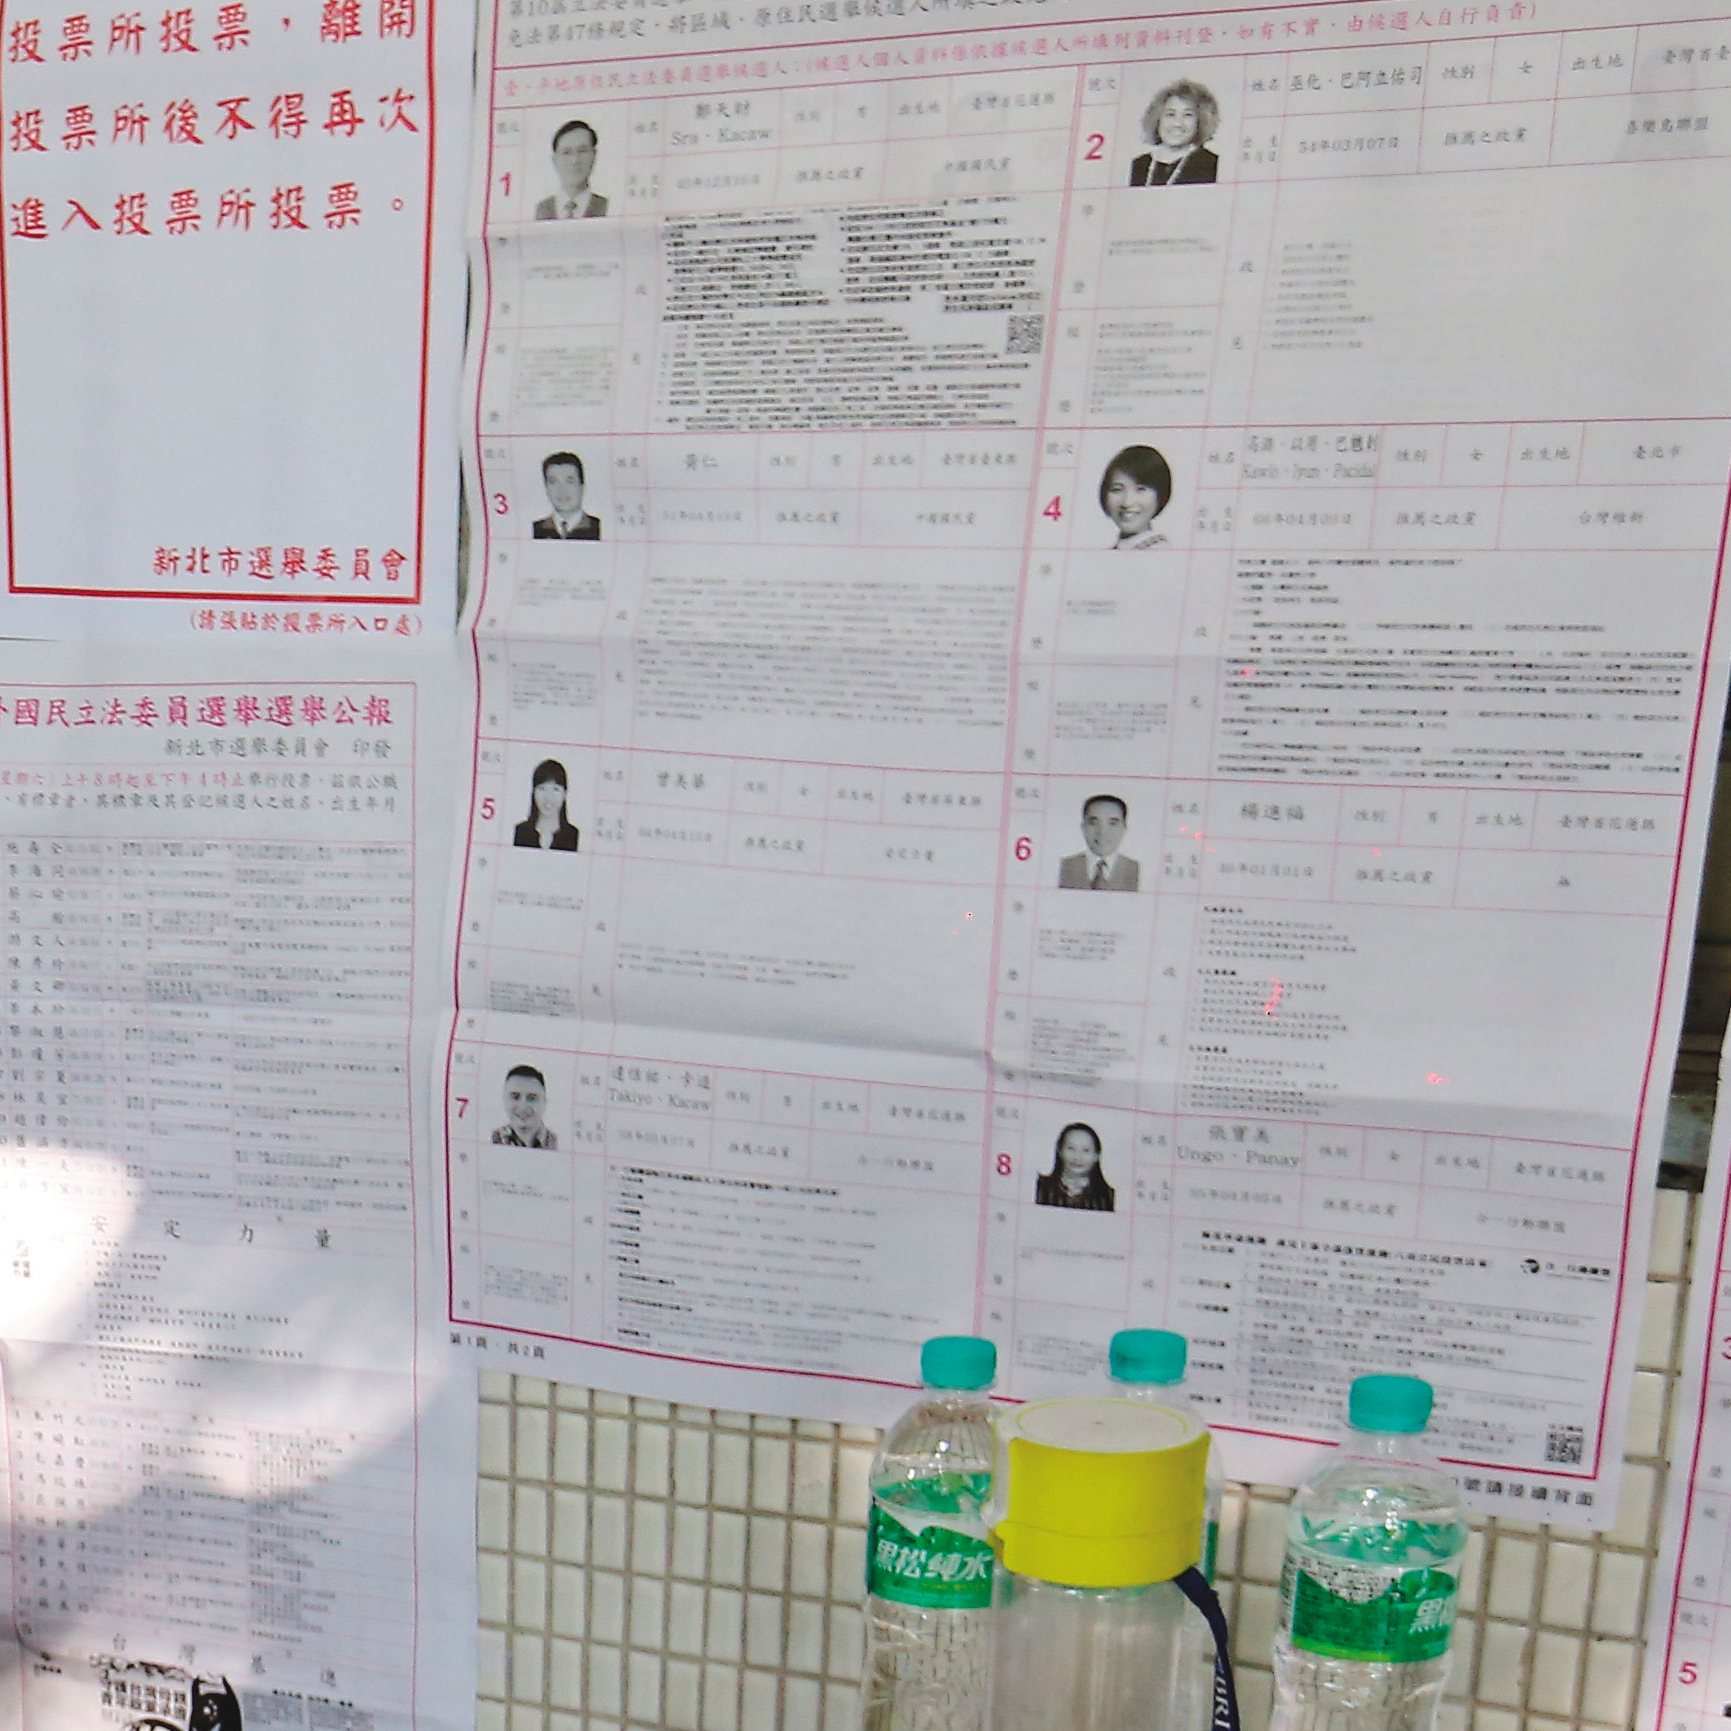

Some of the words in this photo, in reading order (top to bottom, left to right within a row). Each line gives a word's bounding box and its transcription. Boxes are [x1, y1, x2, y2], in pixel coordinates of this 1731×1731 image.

[8, 87, 420, 152] 投票所後不得再次
[1083, 134, 1106, 161] 2
[500, 172, 511, 197] 1
[11, 182, 404, 239] 進入投票所投票。
[494, 493, 510, 515] 3
[1043, 496, 1062, 521] 4
[152, 549, 408, 582] 新北市選舉委員會
[480, 798, 497, 821] 5
[1013, 836, 1033, 862] 6
[455, 1097, 470, 1120] 7
[995, 1153, 1013, 1177] 8
[1678, 1661, 1698, 1685] 5
